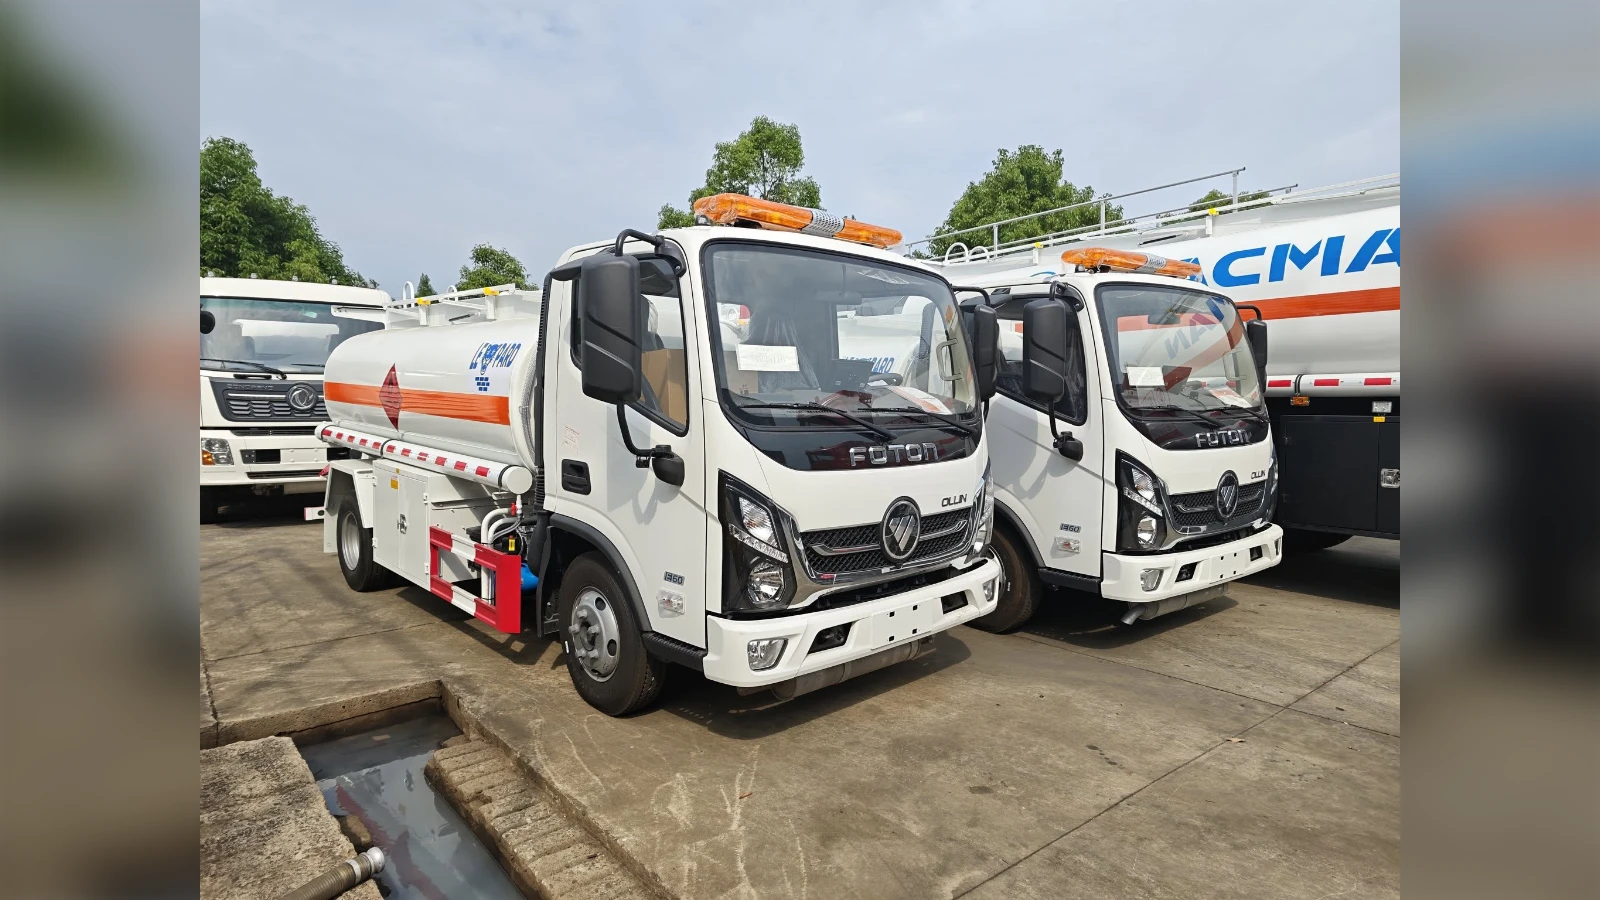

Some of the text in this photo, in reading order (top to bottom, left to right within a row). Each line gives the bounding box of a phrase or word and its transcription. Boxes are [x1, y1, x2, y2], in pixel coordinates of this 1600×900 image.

[1195, 429, 1249, 448] FOTON
[849, 442, 938, 467] FOTON
[941, 493, 968, 507] OLLIN
